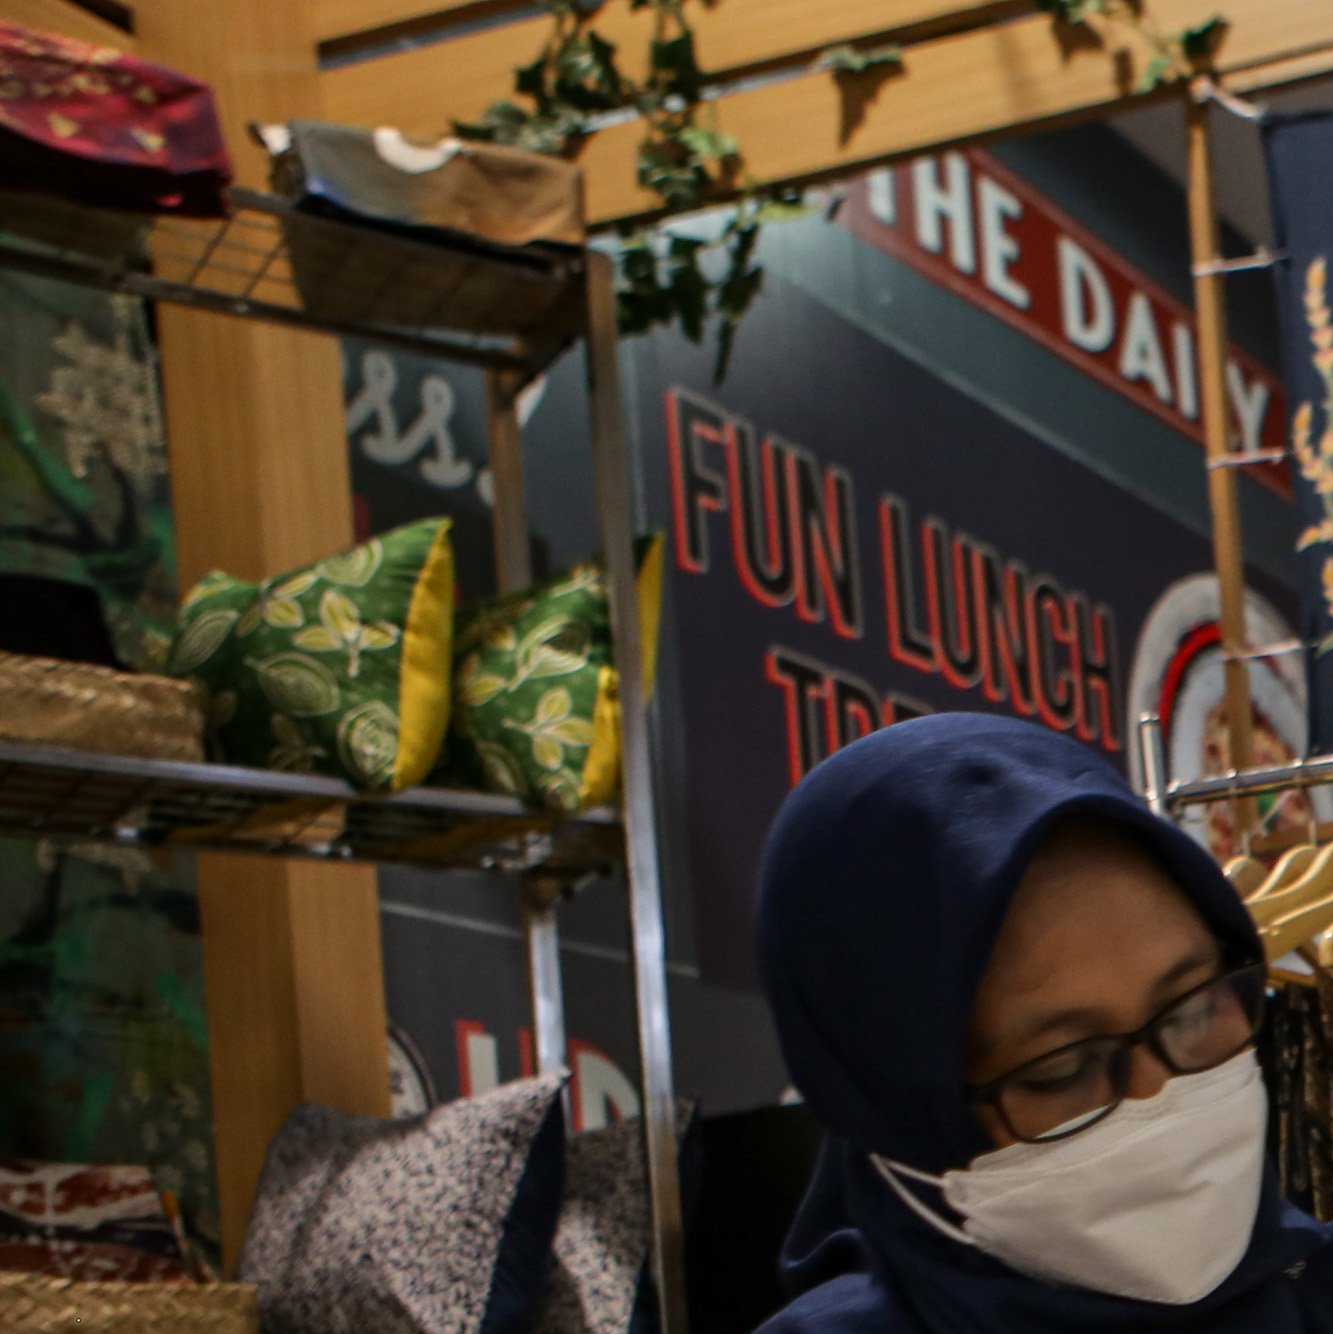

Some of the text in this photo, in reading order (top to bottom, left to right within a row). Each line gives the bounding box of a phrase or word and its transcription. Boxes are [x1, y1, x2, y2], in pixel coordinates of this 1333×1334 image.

[1055, 233, 1269, 455] DAIY
[665, 385, 866, 641] FUN
[879, 492, 1120, 753] LUNCH
